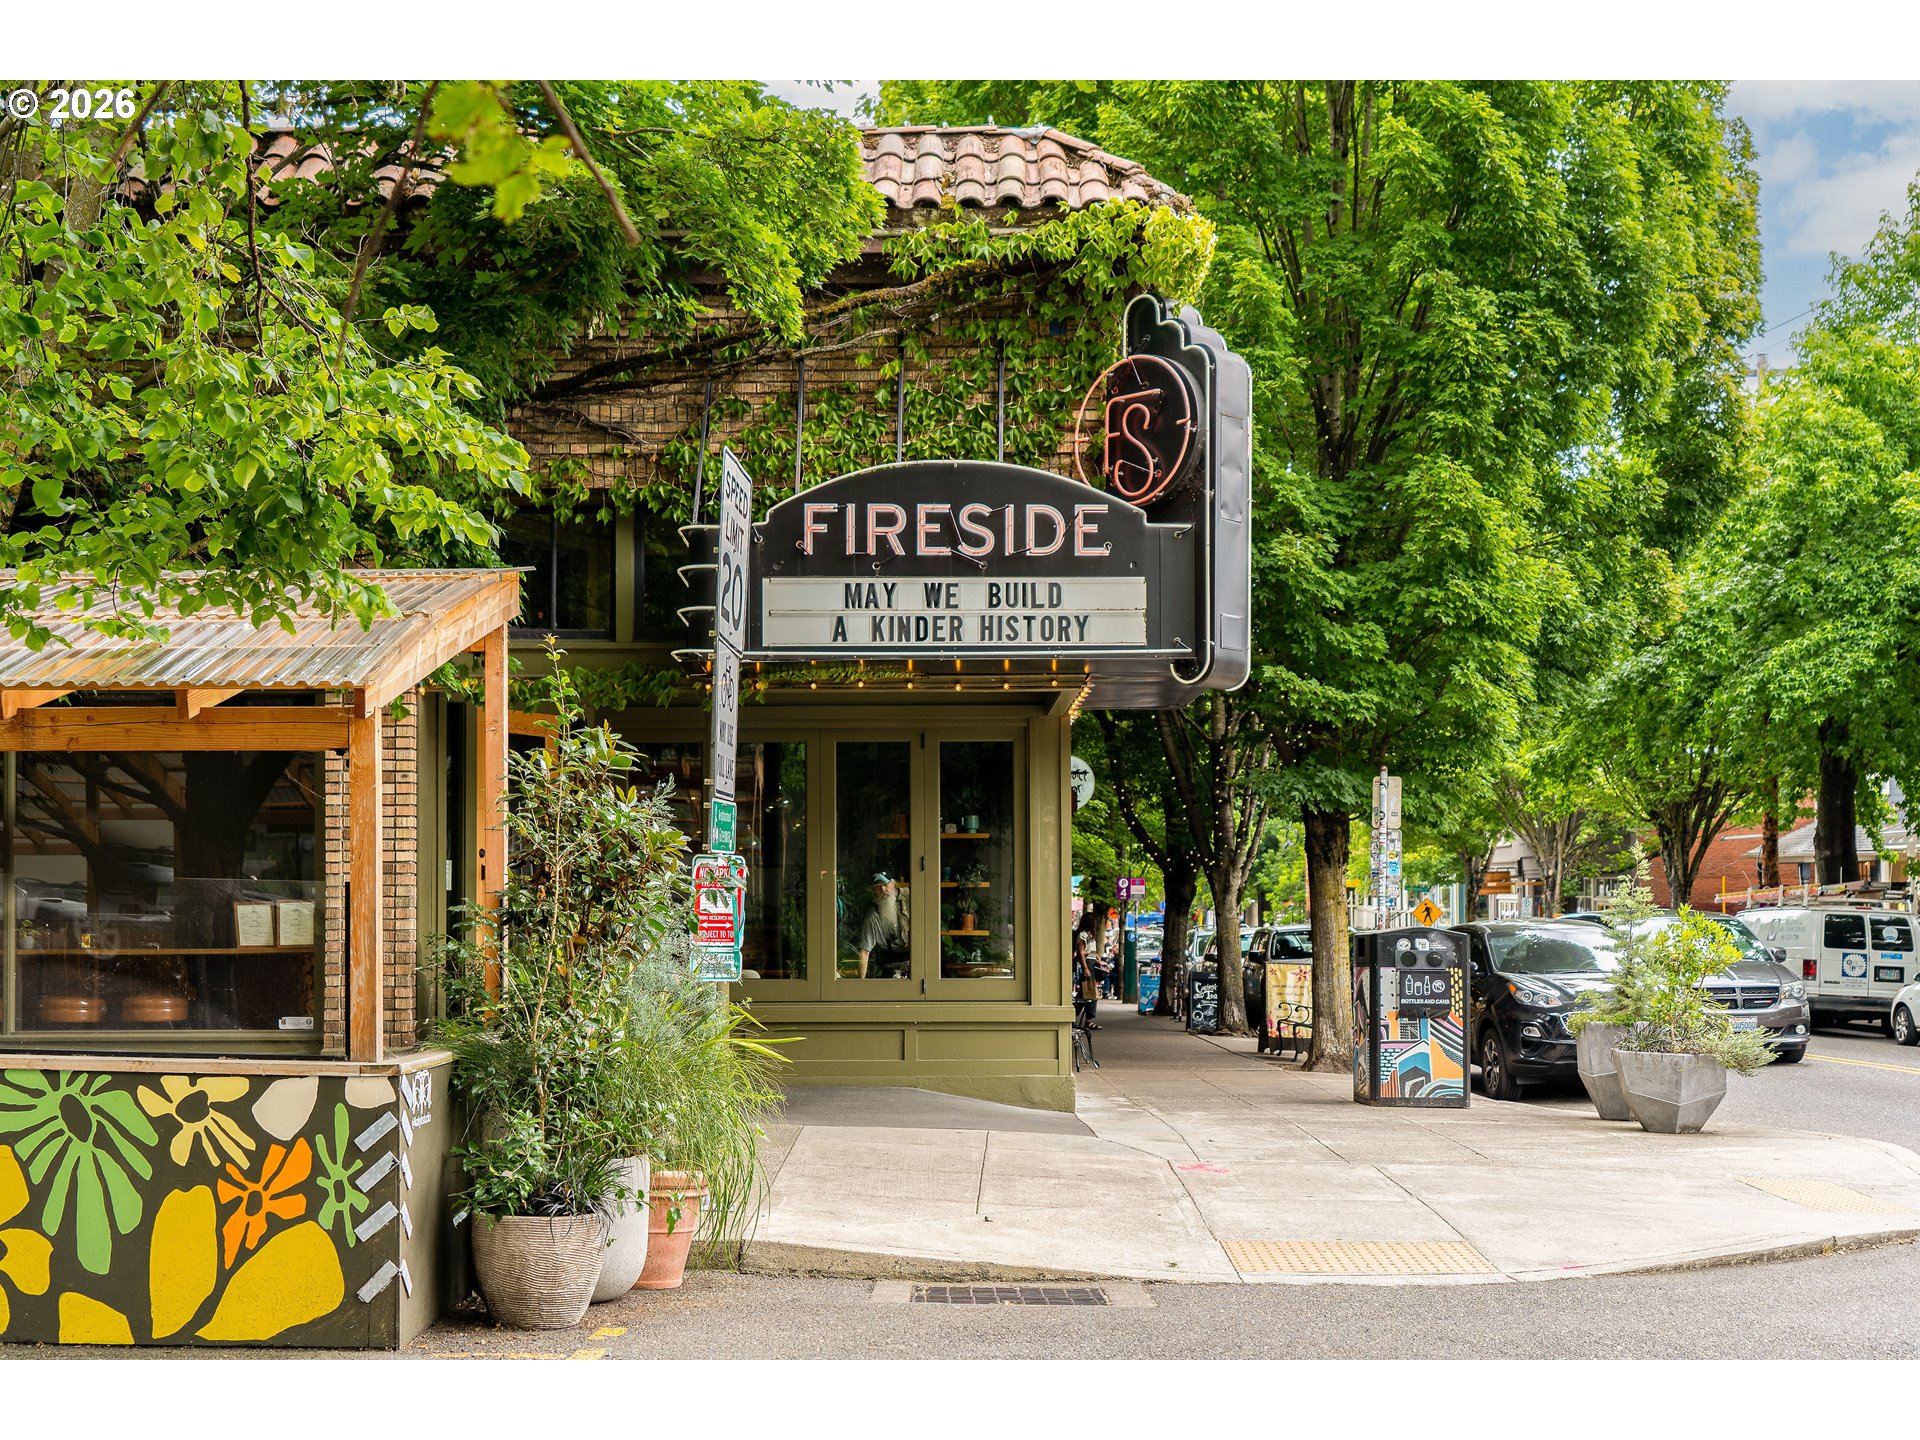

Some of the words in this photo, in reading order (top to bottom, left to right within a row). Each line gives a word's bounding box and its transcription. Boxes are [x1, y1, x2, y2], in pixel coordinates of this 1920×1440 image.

[725, 470, 748, 520] SPEED
[725, 511, 745, 555] LIMIT
[803, 502, 1110, 557] FIRESIDE
[721, 551, 743, 632] 20
[844, 582, 897, 609] MAY
[924, 582, 958, 609] WE
[987, 582, 1062, 609] BUILD
[832, 616, 847, 642] A
[871, 615, 963, 642] KINDER
[979, 614, 1090, 641] HISTORY
[719, 930, 727, 938] TO
